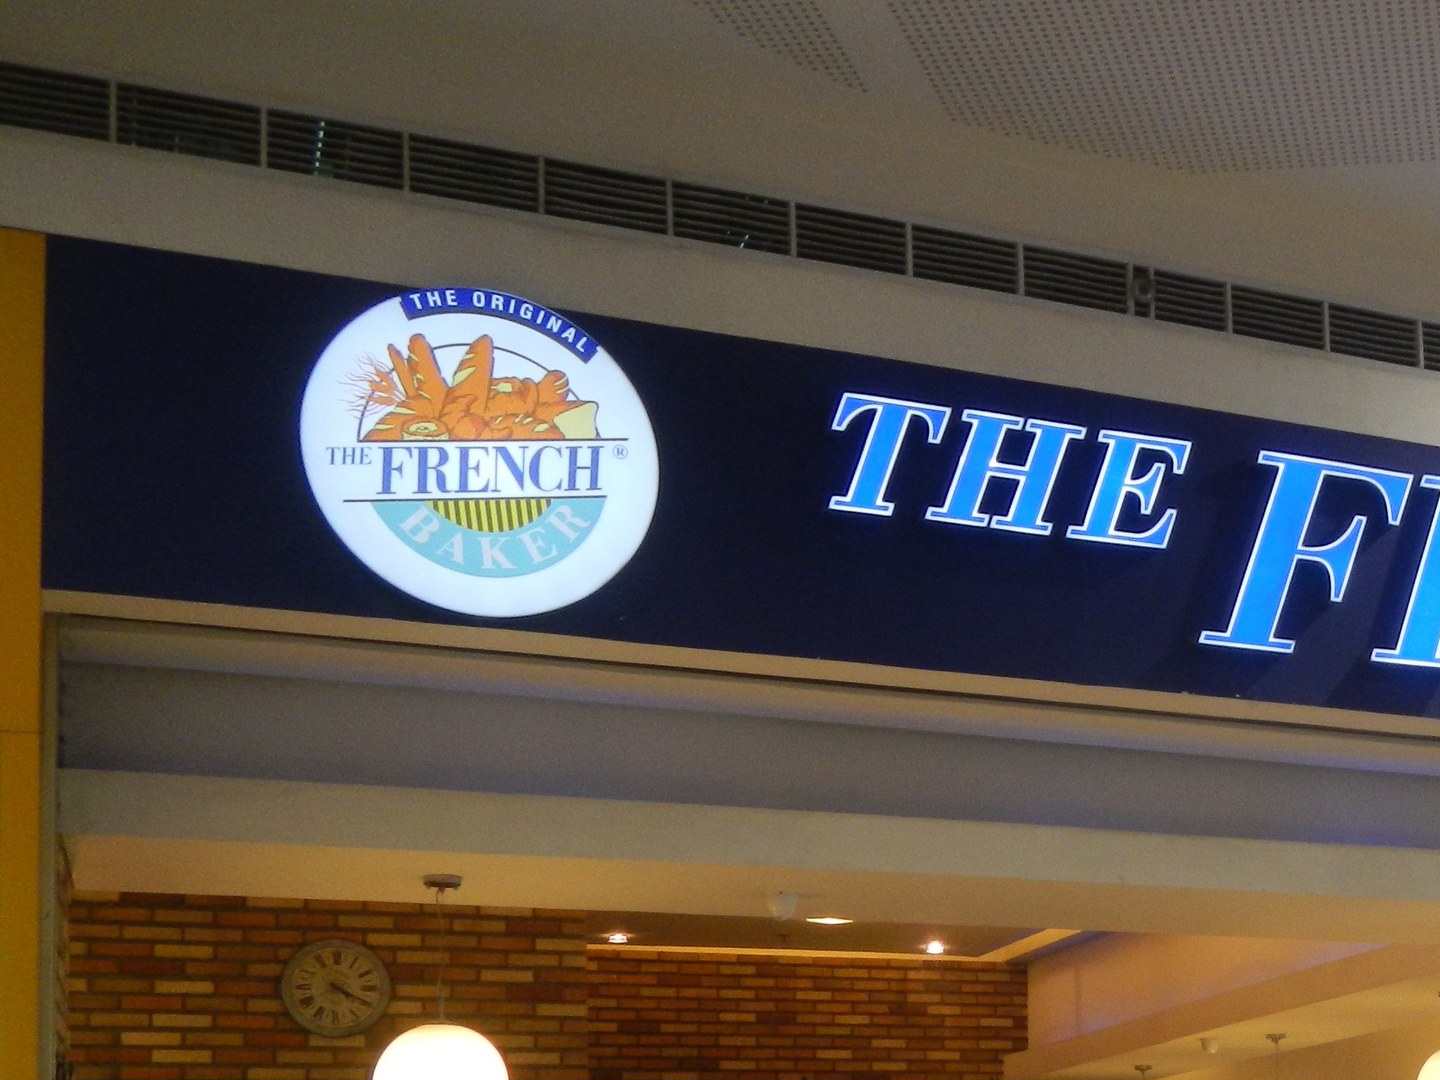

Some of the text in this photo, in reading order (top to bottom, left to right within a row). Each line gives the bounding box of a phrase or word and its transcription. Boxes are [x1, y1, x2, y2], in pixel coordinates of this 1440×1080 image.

[409, 290, 587, 353] THE ORIGINAL
[326, 445, 605, 495] THE FRENCH
[827, 391, 1193, 550] THE
[400, 504, 591, 570] BAKER
